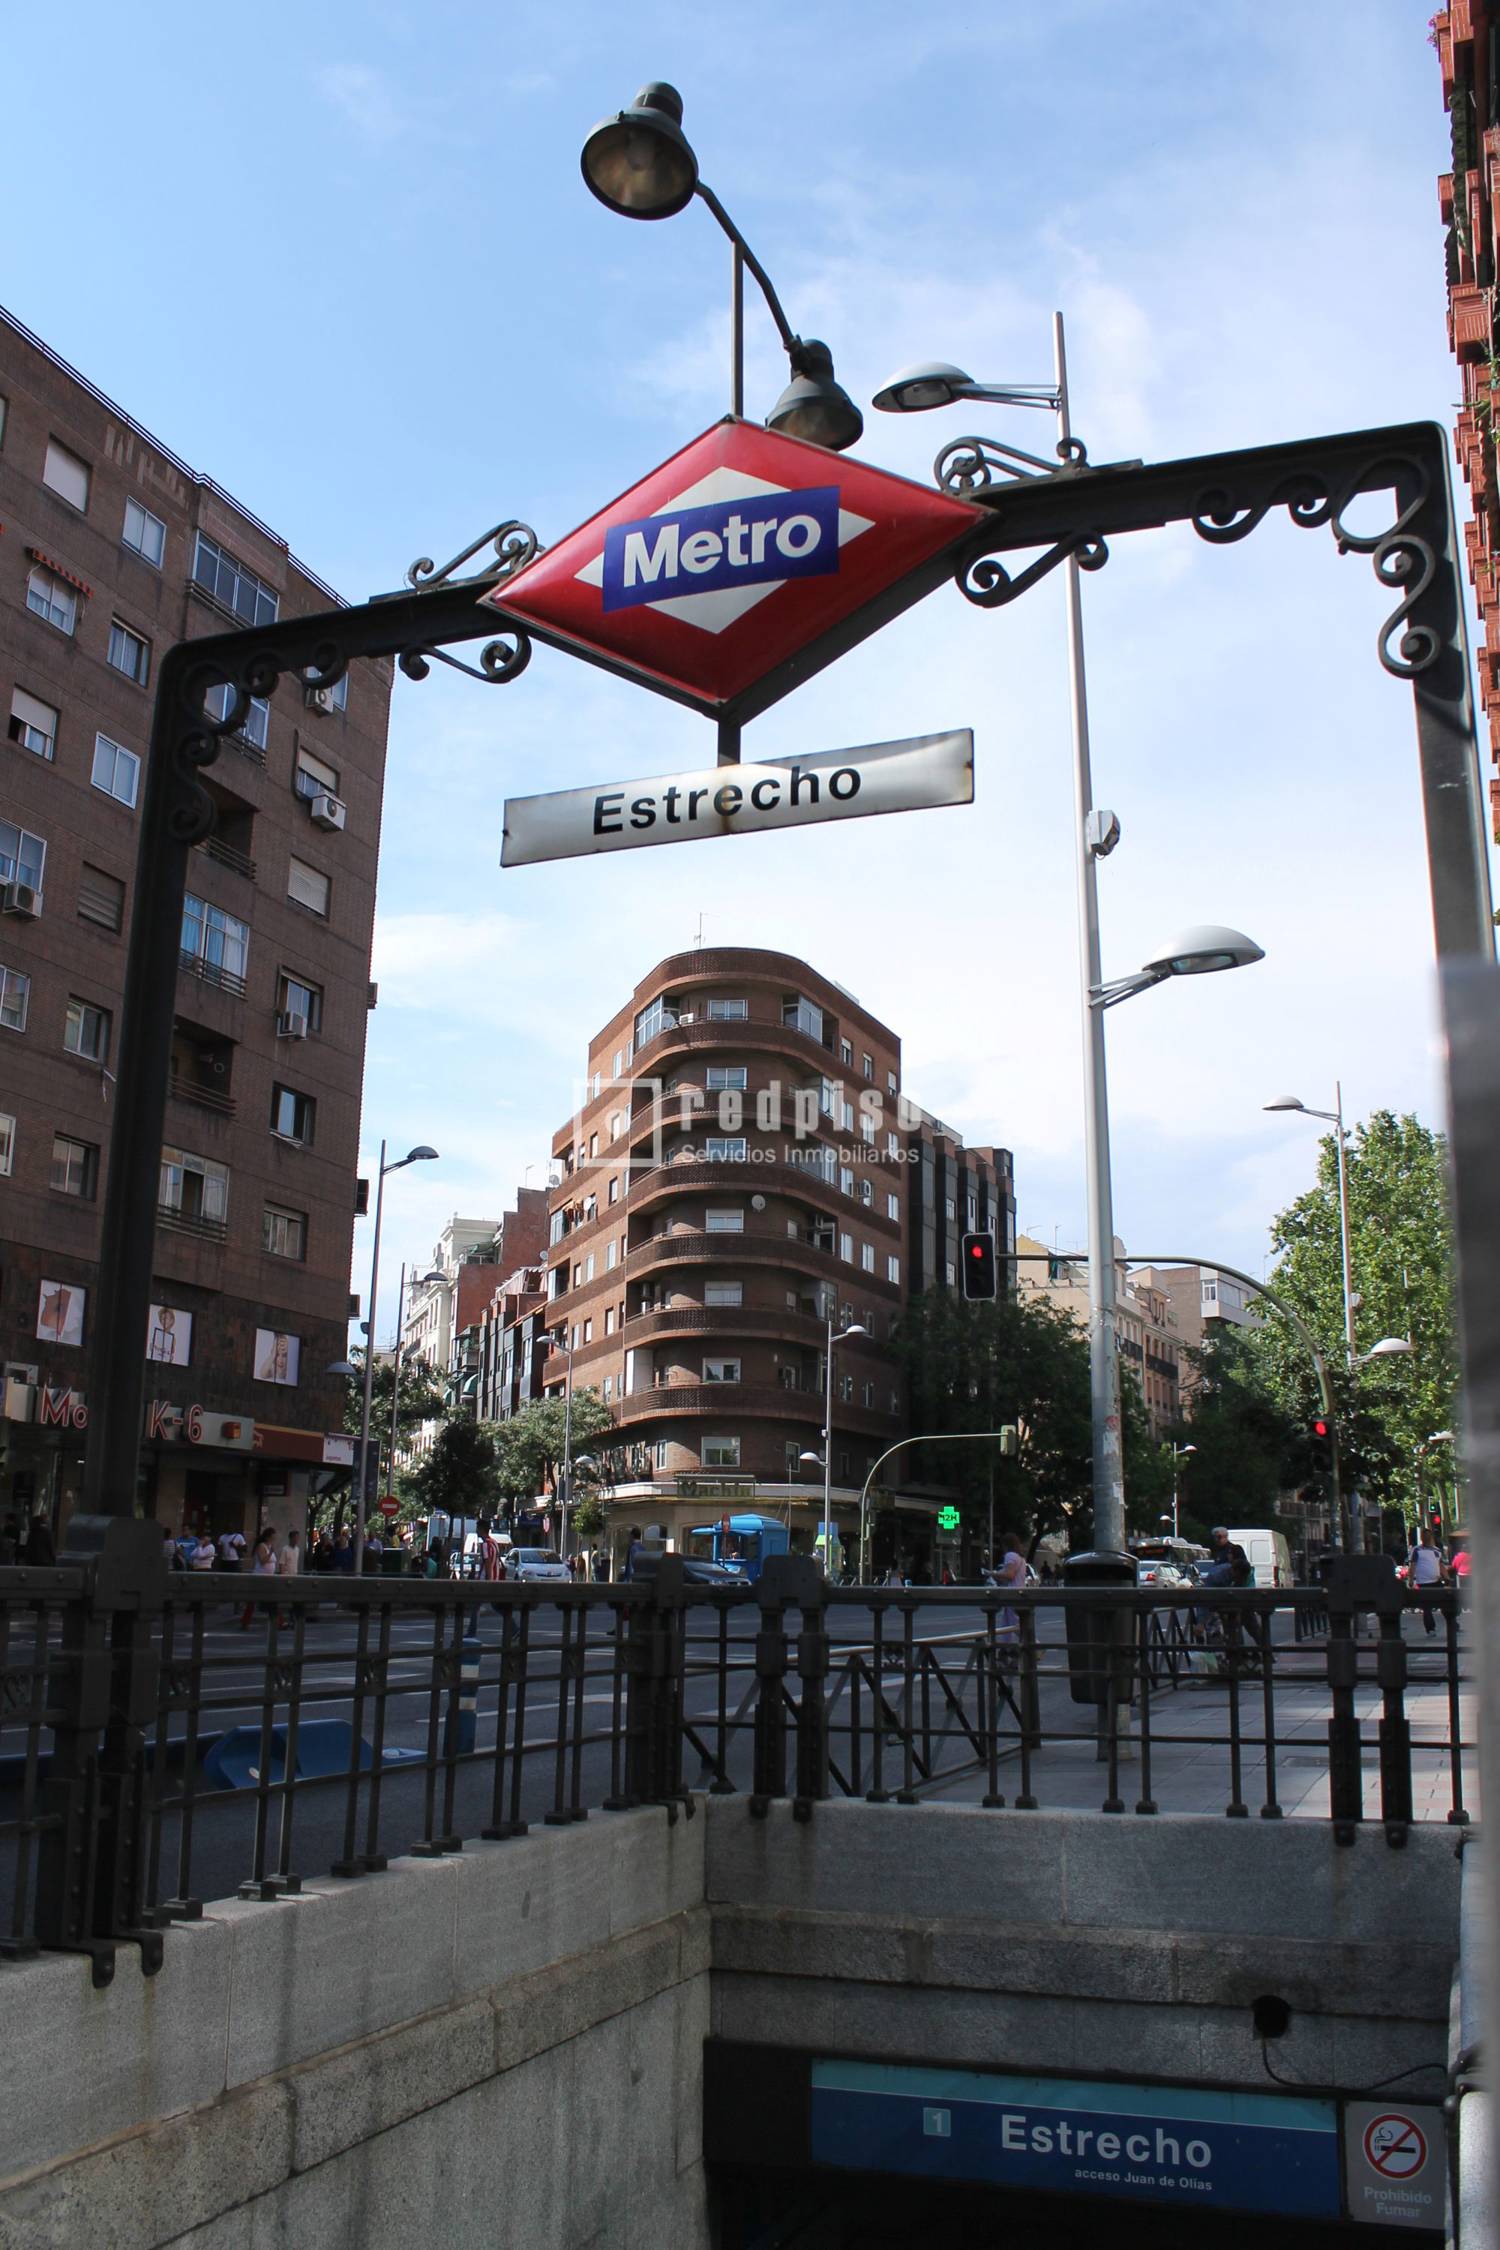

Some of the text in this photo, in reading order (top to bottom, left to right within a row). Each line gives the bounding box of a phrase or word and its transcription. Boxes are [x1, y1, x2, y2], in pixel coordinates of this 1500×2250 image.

[623, 513, 822, 588] Metro
[593, 766, 861, 835] Estrecho
[151, 1399, 204, 1444] K-6
[931, 2112, 943, 2133] 1
[1001, 2114, 1212, 2168] Estrecho
[1074, 2168, 1120, 2182] acceso
[1124, 2172, 1155, 2185] Juan
[1159, 2175, 1175, 2187] de
[1363, 2185, 1432, 2205] Prohibido
[1376, 2202, 1422, 2218] Fumar
